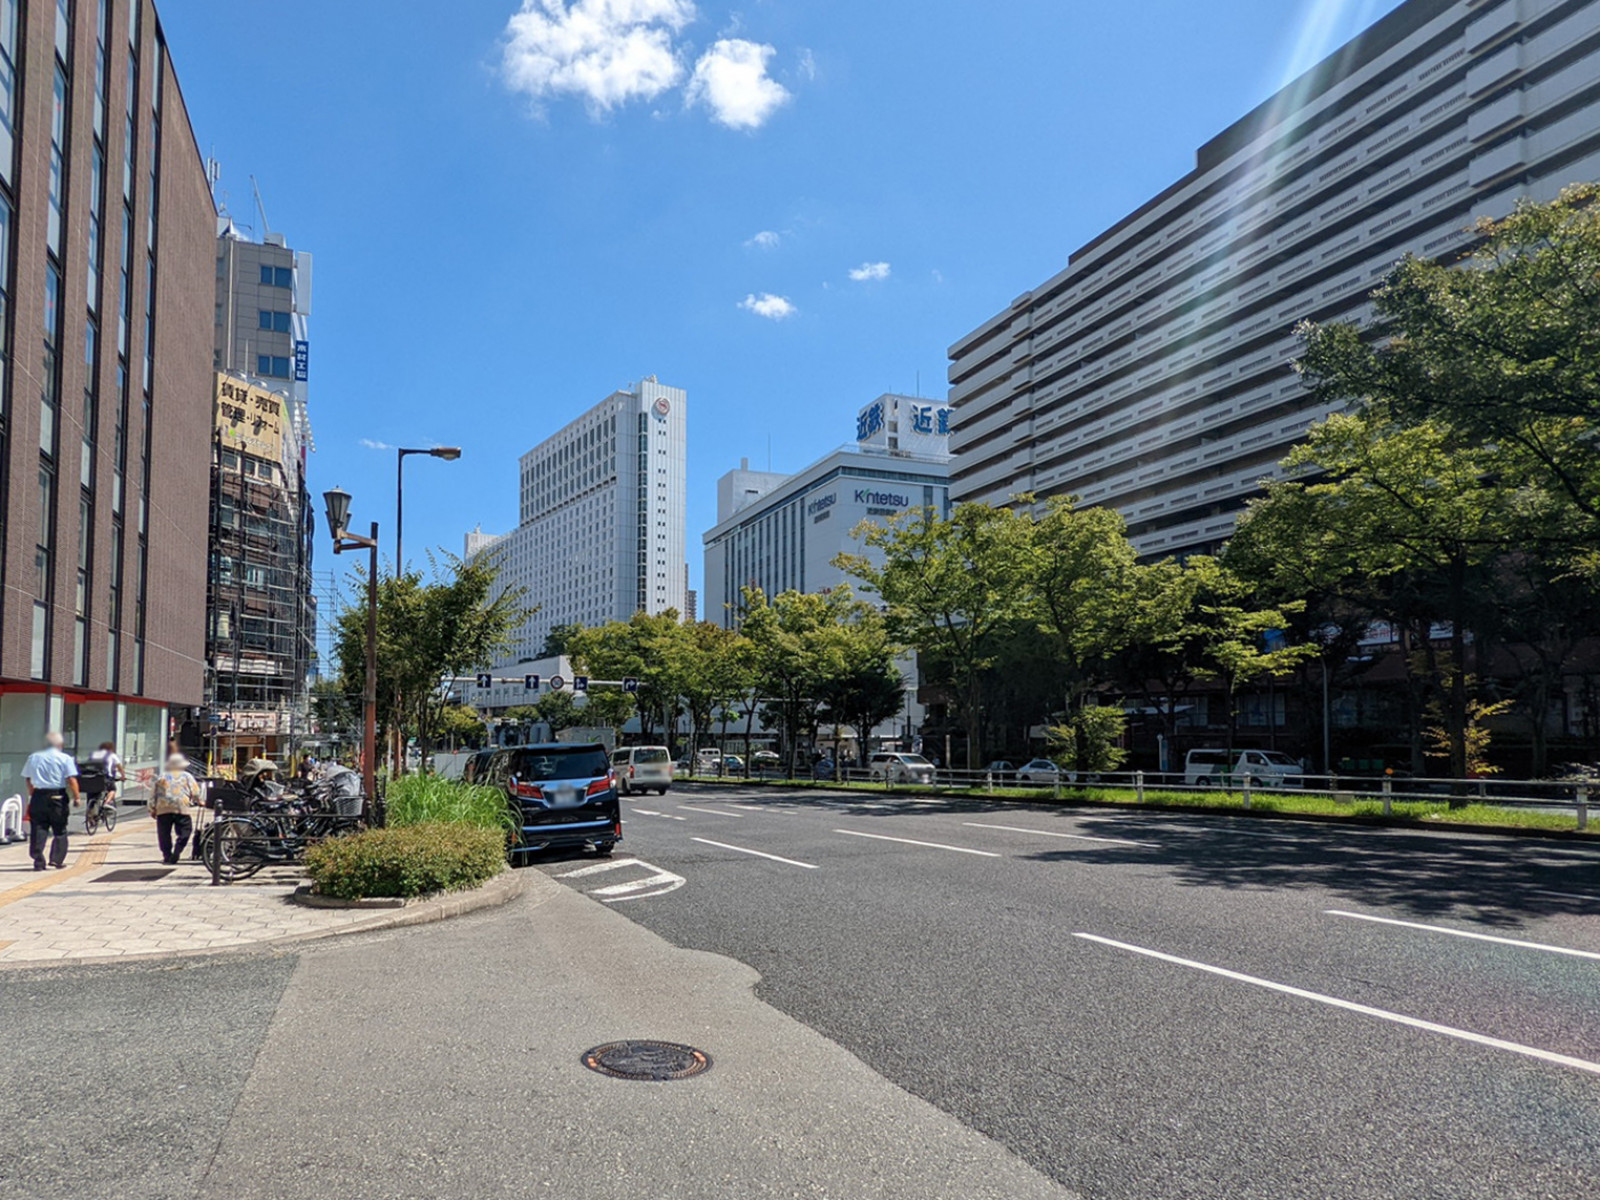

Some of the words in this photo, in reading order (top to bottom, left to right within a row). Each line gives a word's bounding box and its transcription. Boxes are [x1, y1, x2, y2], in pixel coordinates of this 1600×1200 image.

[221, 382, 280, 417] 賃貸・売買
[856, 403, 882, 442] 近鉄
[807, 492, 837, 516] Kintetsu
[854, 489, 909, 507] Kintetsu
